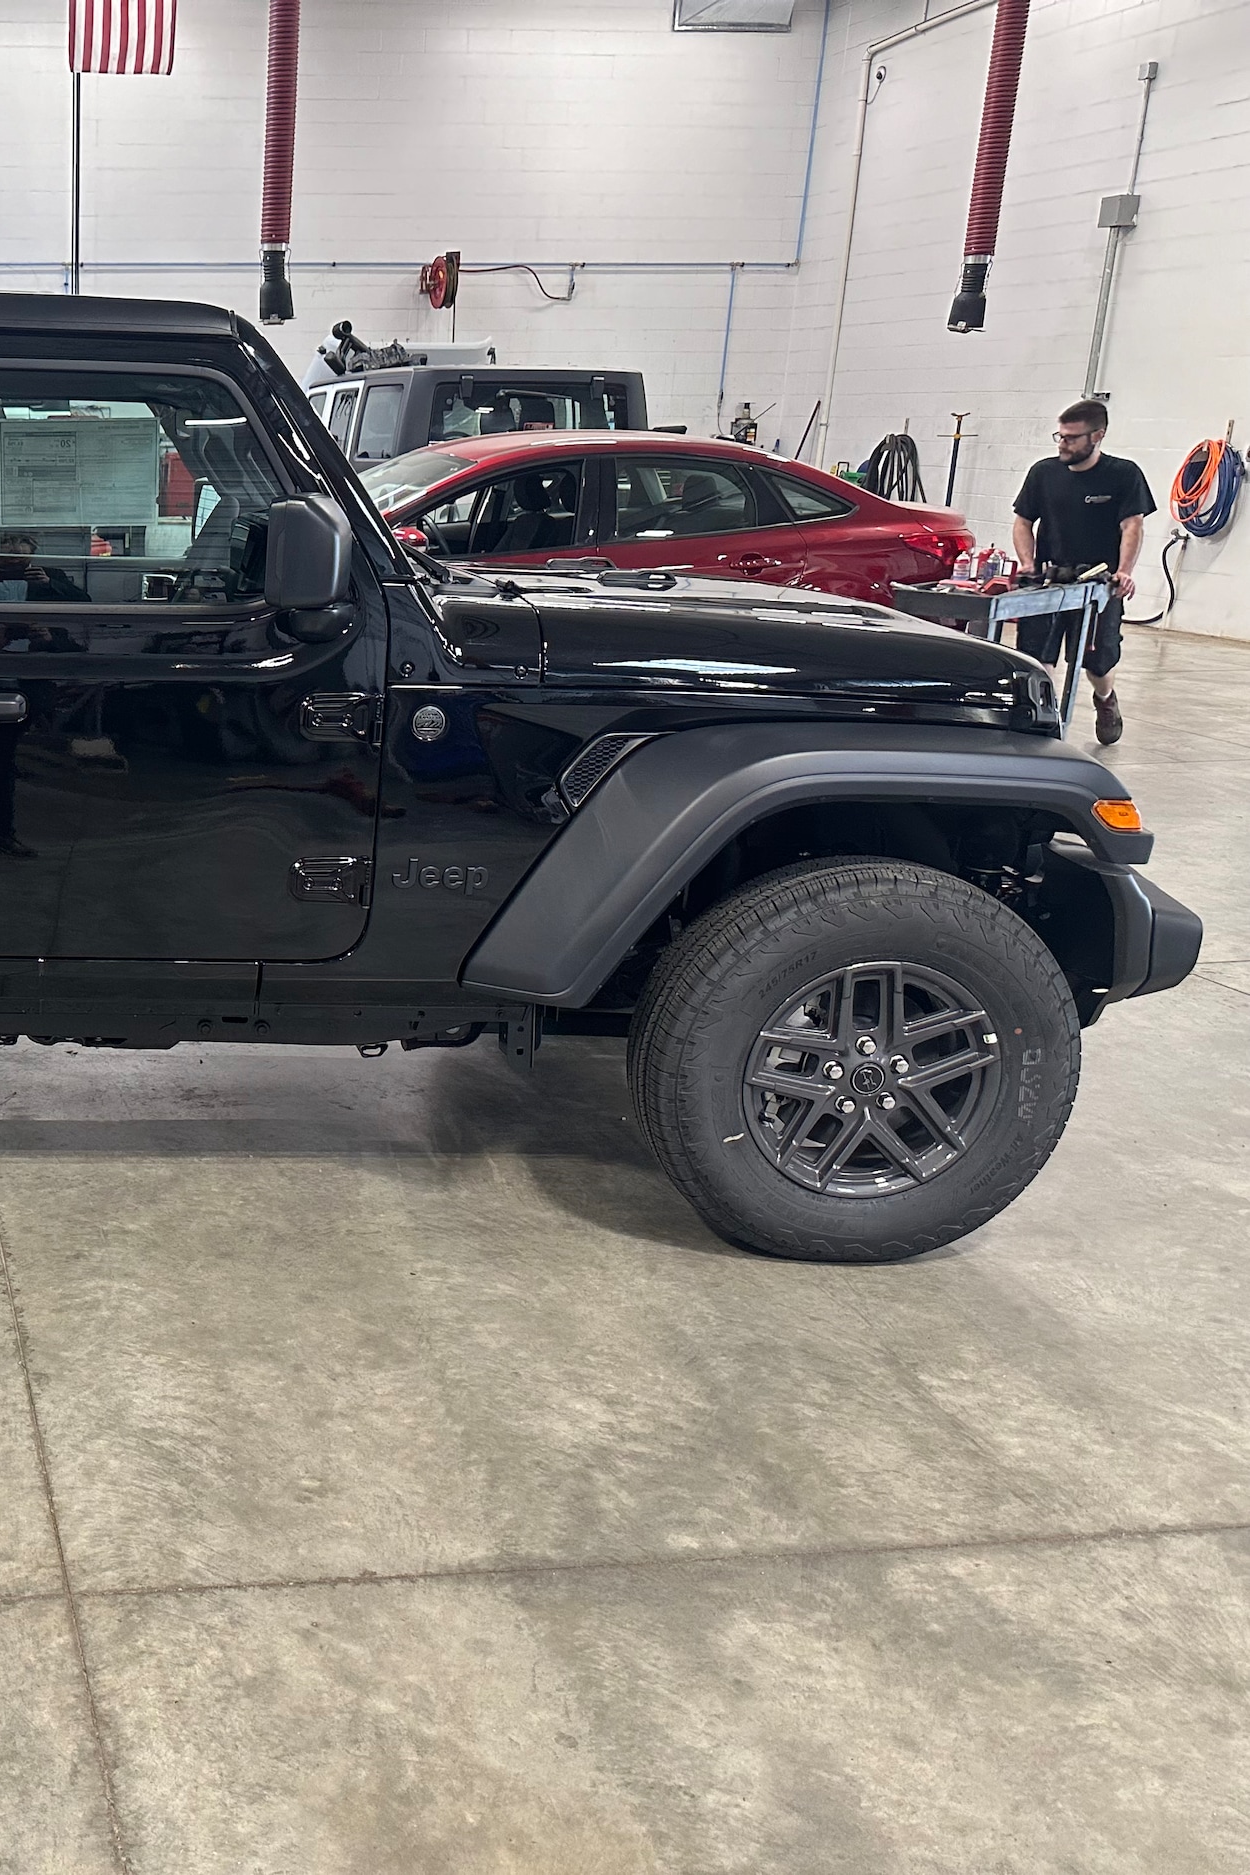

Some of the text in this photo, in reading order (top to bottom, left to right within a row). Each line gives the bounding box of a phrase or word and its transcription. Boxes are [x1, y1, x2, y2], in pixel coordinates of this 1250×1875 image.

[391, 857, 489, 896] Jeep
[758, 950, 818, 1000] 245/75R17
[969, 1131, 1024, 1195] All-Weather
